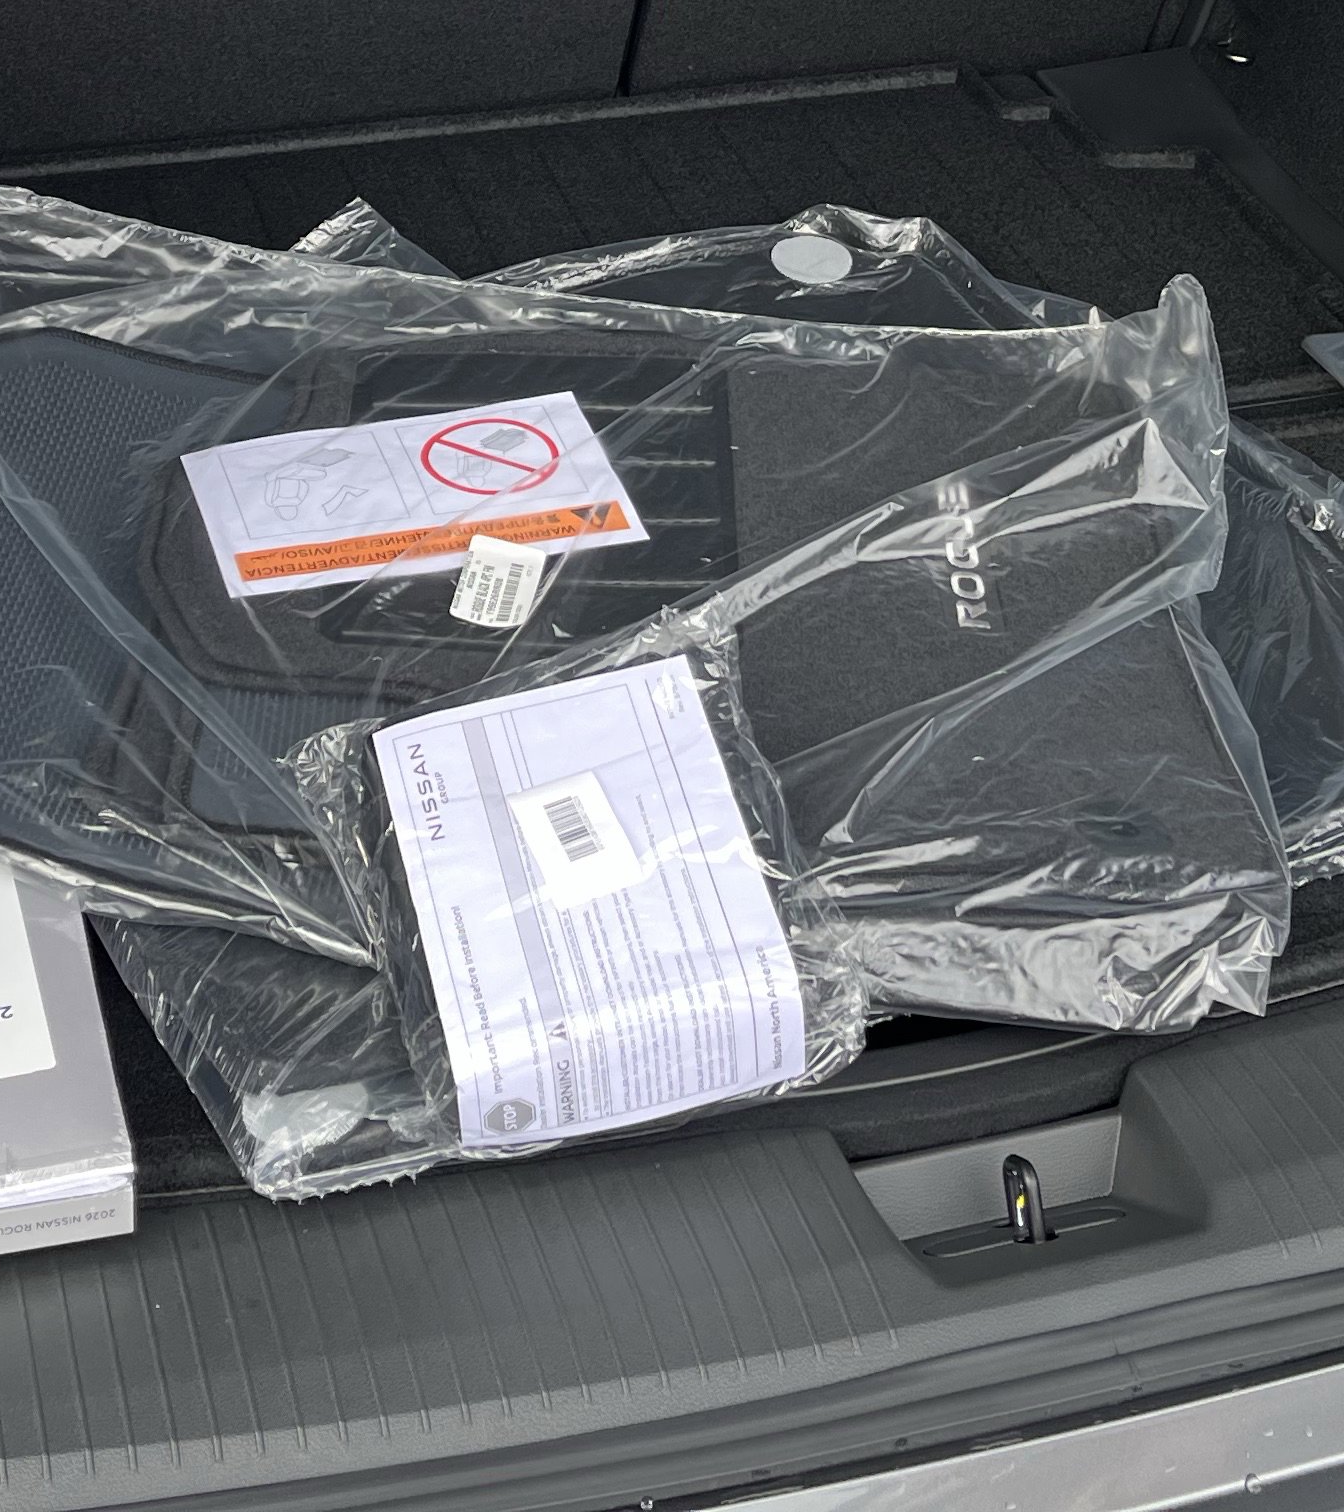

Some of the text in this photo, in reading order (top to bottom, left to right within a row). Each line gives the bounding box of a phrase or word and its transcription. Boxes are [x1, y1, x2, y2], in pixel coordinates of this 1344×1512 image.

[407, 743, 445, 841] NISSAN
[434, 770, 449, 804] GROUP
[465, 966, 482, 1001] Before
[474, 1002, 490, 1030] Read
[767, 1000, 780, 1035] North
[556, 1059, 575, 1123] WARNING
[502, 1103, 517, 1131] STOP
[35, 1213, 82, 1231] NISSAN
[85, 1208, 116, 1221] 2026
